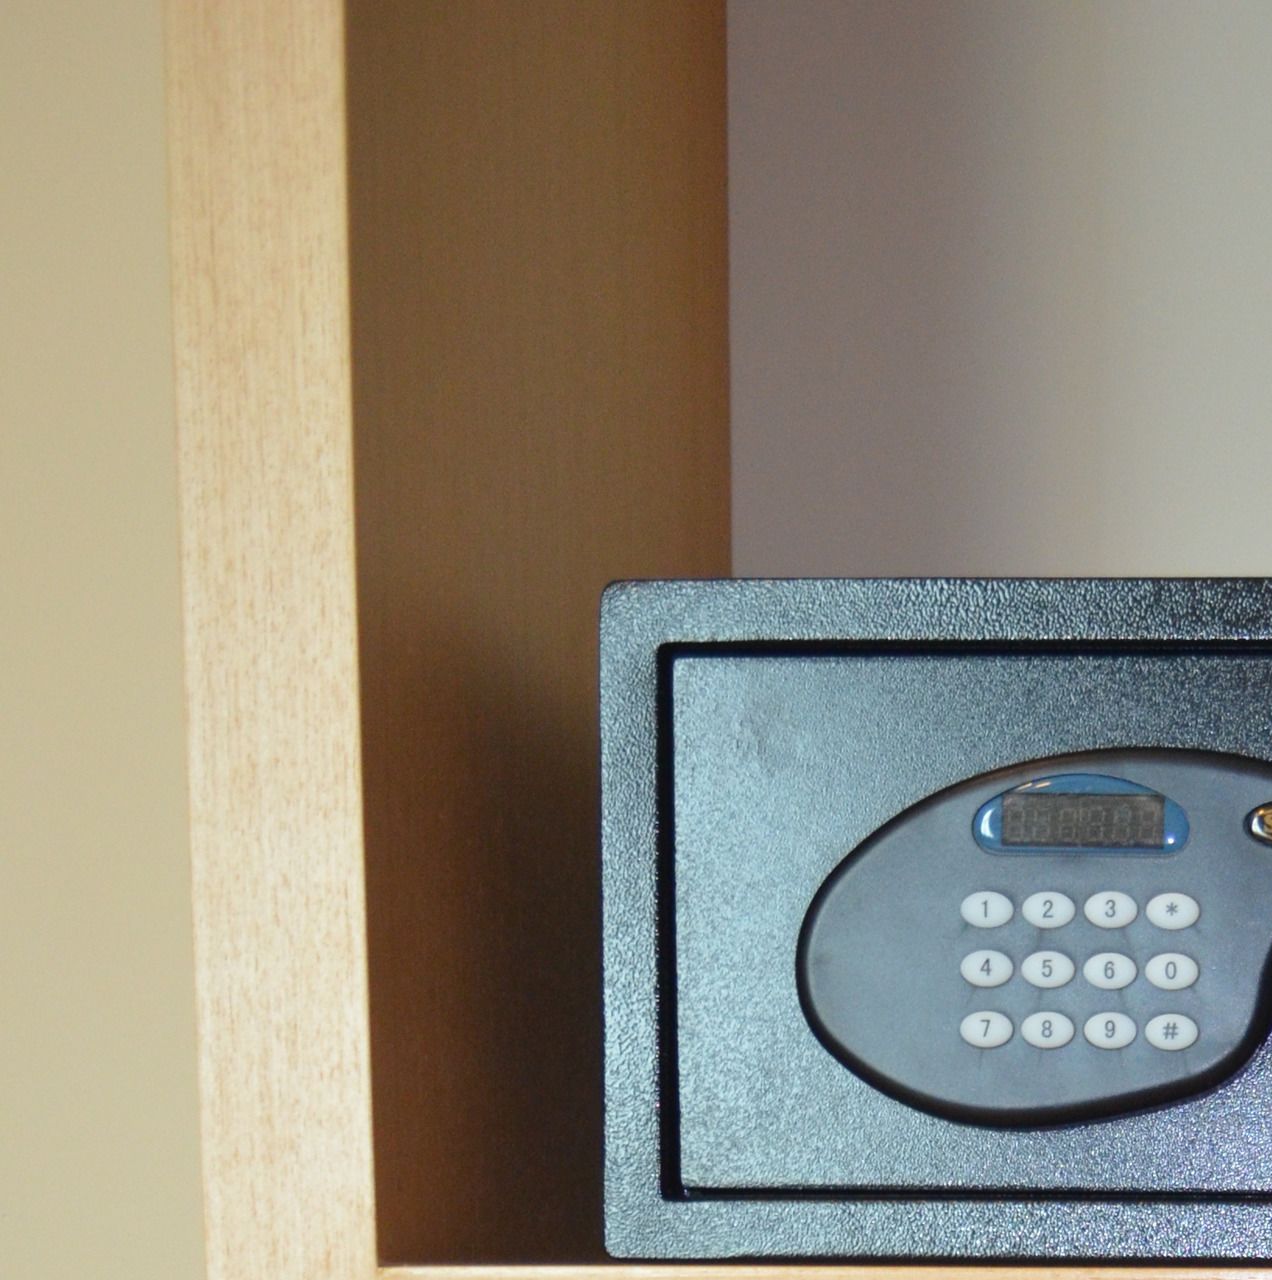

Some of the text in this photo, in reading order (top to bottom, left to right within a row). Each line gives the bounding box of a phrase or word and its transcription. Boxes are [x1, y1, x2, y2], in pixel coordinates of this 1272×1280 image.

[1042, 899, 1054, 919] 2
[1104, 899, 1117, 919] 3
[979, 957, 993, 977] 4
[1041, 958, 1053, 979] 5
[1103, 960, 1115, 980] 6
[1165, 961, 1177, 981] 0
[979, 1019, 991, 1038] 7
[1041, 1019, 1053, 1040] 8
[1104, 1019, 1115, 1039] 9
[1162, 1021, 1179, 1041] #
